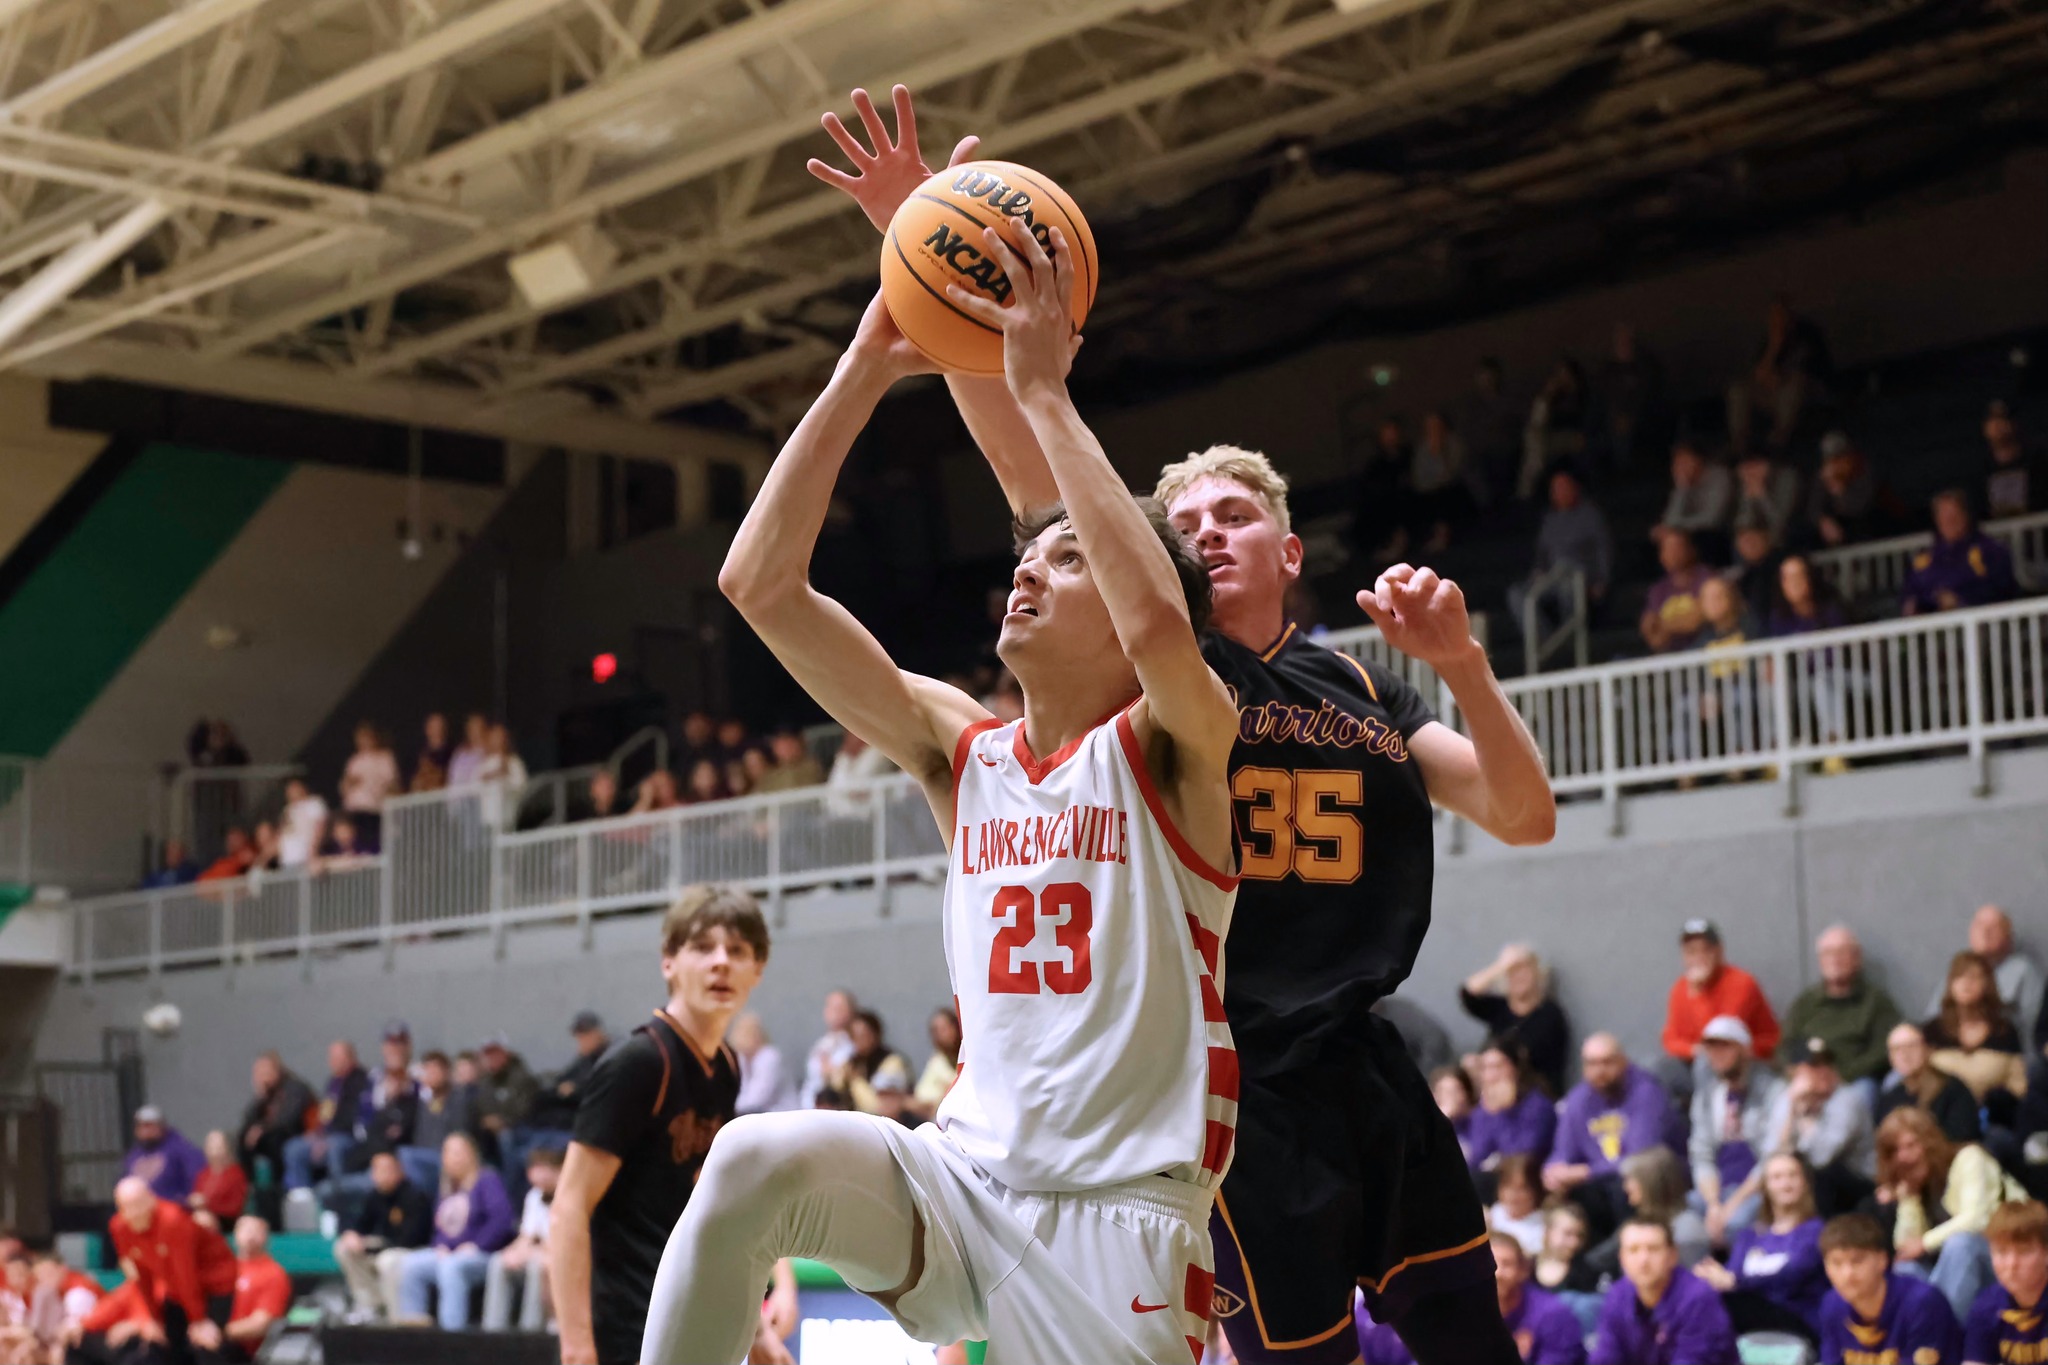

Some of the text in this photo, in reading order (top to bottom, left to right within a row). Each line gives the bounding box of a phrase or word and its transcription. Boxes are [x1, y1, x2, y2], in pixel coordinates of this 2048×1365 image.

[923, 223, 1013, 304] NCAA
[1226, 684, 1408, 762] arriors
[962, 805, 1128, 875] LAWRENCEVILLE
[1231, 765, 1364, 884] 35
[988, 882, 1093, 995] 23
